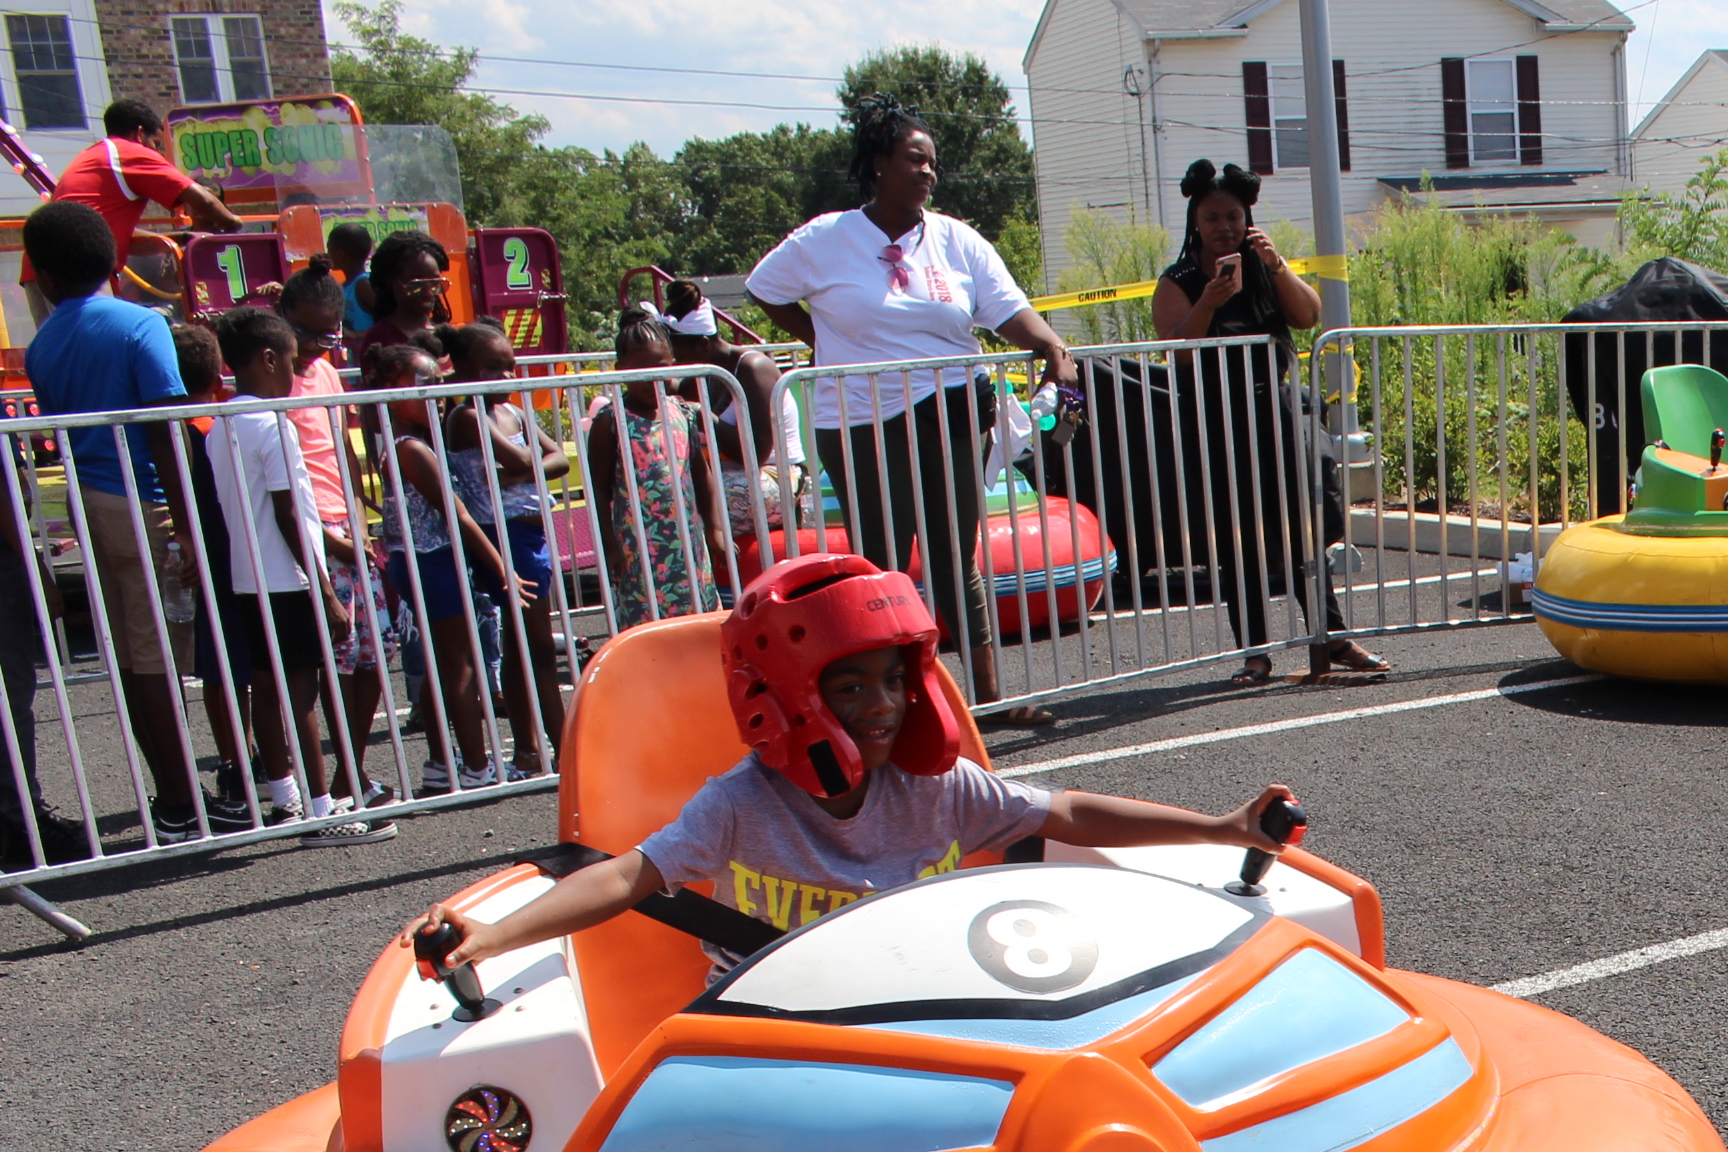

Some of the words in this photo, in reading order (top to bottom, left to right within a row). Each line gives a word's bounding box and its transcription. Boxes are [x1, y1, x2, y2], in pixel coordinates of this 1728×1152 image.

[180, 129, 262, 170] SUPER
[264, 122, 344, 165] SONIC
[216, 245, 248, 304] 1
[503, 237, 533, 290] 2
[934, 278, 953, 303] 2018
[1078, 288, 1117, 302] CAUTION
[986, 907, 1073, 979] 8
